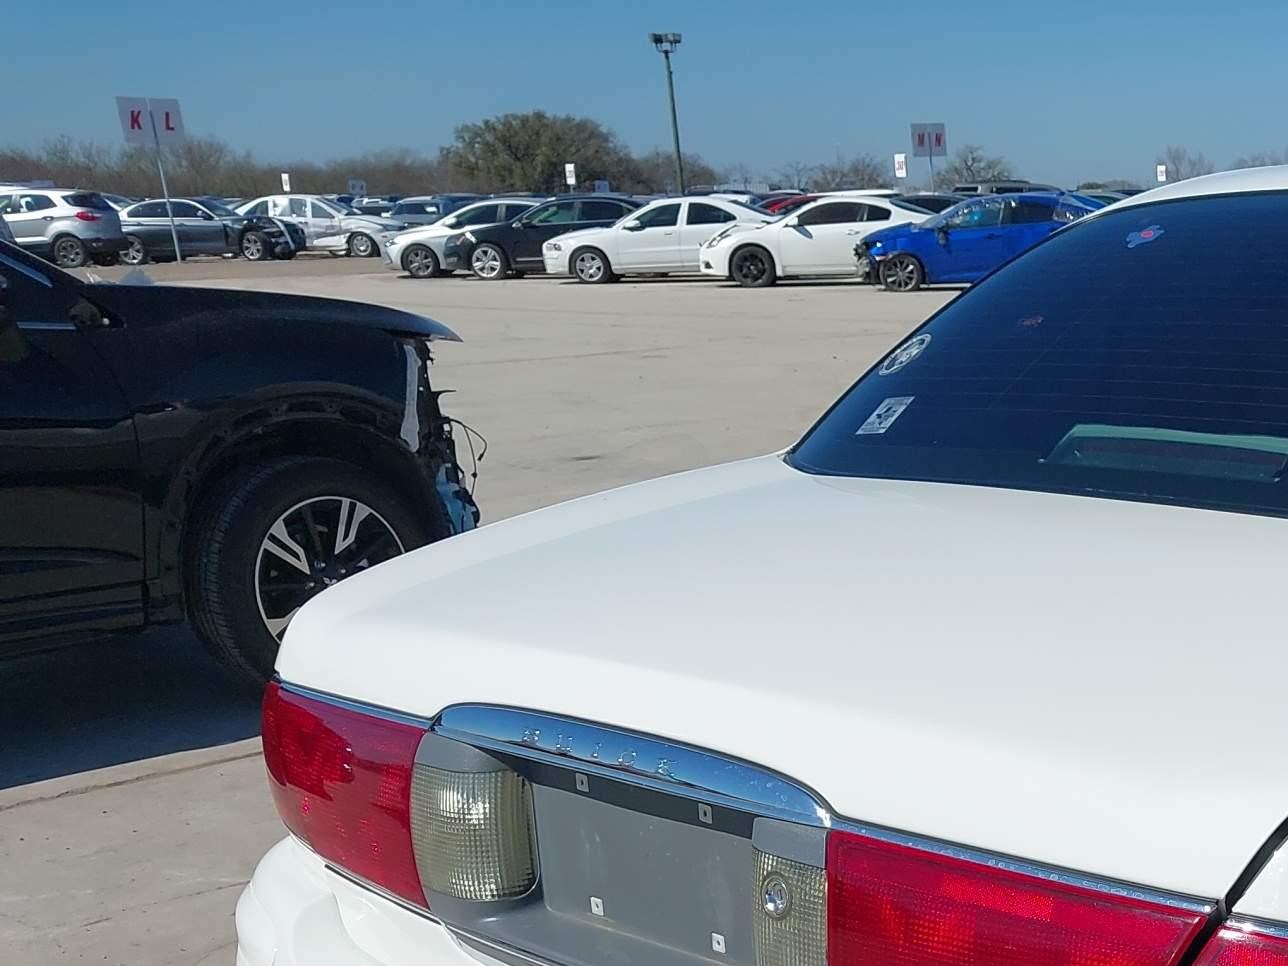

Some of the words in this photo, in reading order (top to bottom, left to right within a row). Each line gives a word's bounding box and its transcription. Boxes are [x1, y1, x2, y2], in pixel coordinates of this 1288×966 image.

[130, 110, 143, 130] K
[165, 111, 175, 131] L
[522, 729, 678, 778] BUICK
